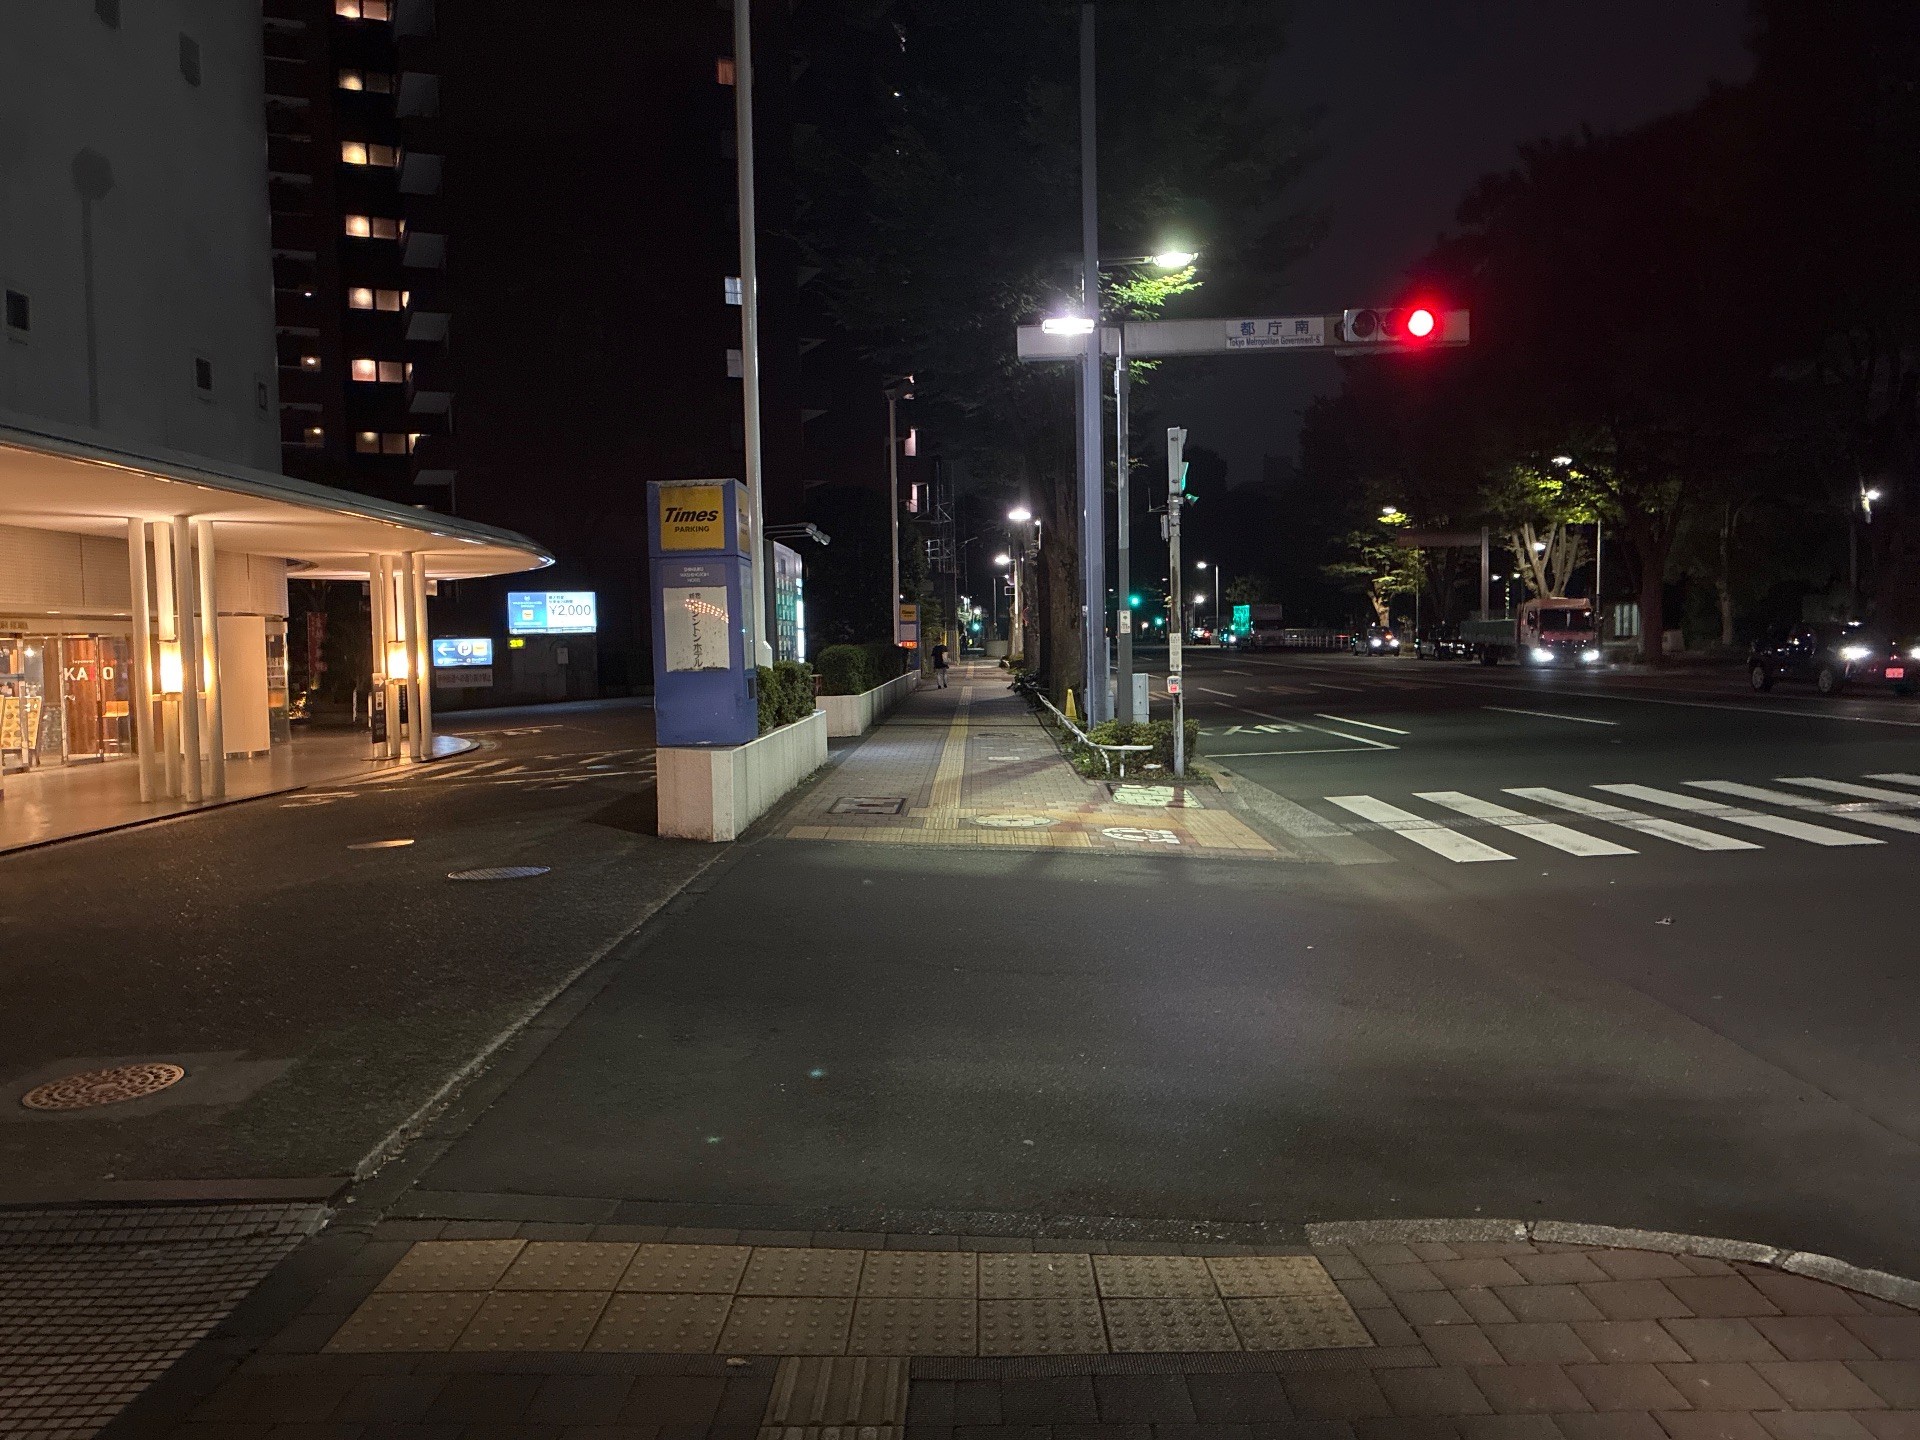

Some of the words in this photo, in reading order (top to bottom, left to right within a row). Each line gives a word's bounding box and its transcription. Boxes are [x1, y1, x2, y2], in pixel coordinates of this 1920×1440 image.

[1240, 320, 1310, 336] 都庁南
[1228, 337, 1245, 347] Tokyo
[1246, 336, 1280, 347] Metropolitan
[665, 507, 719, 522] Times
[549, 604, 592, 616] ¥2,000
